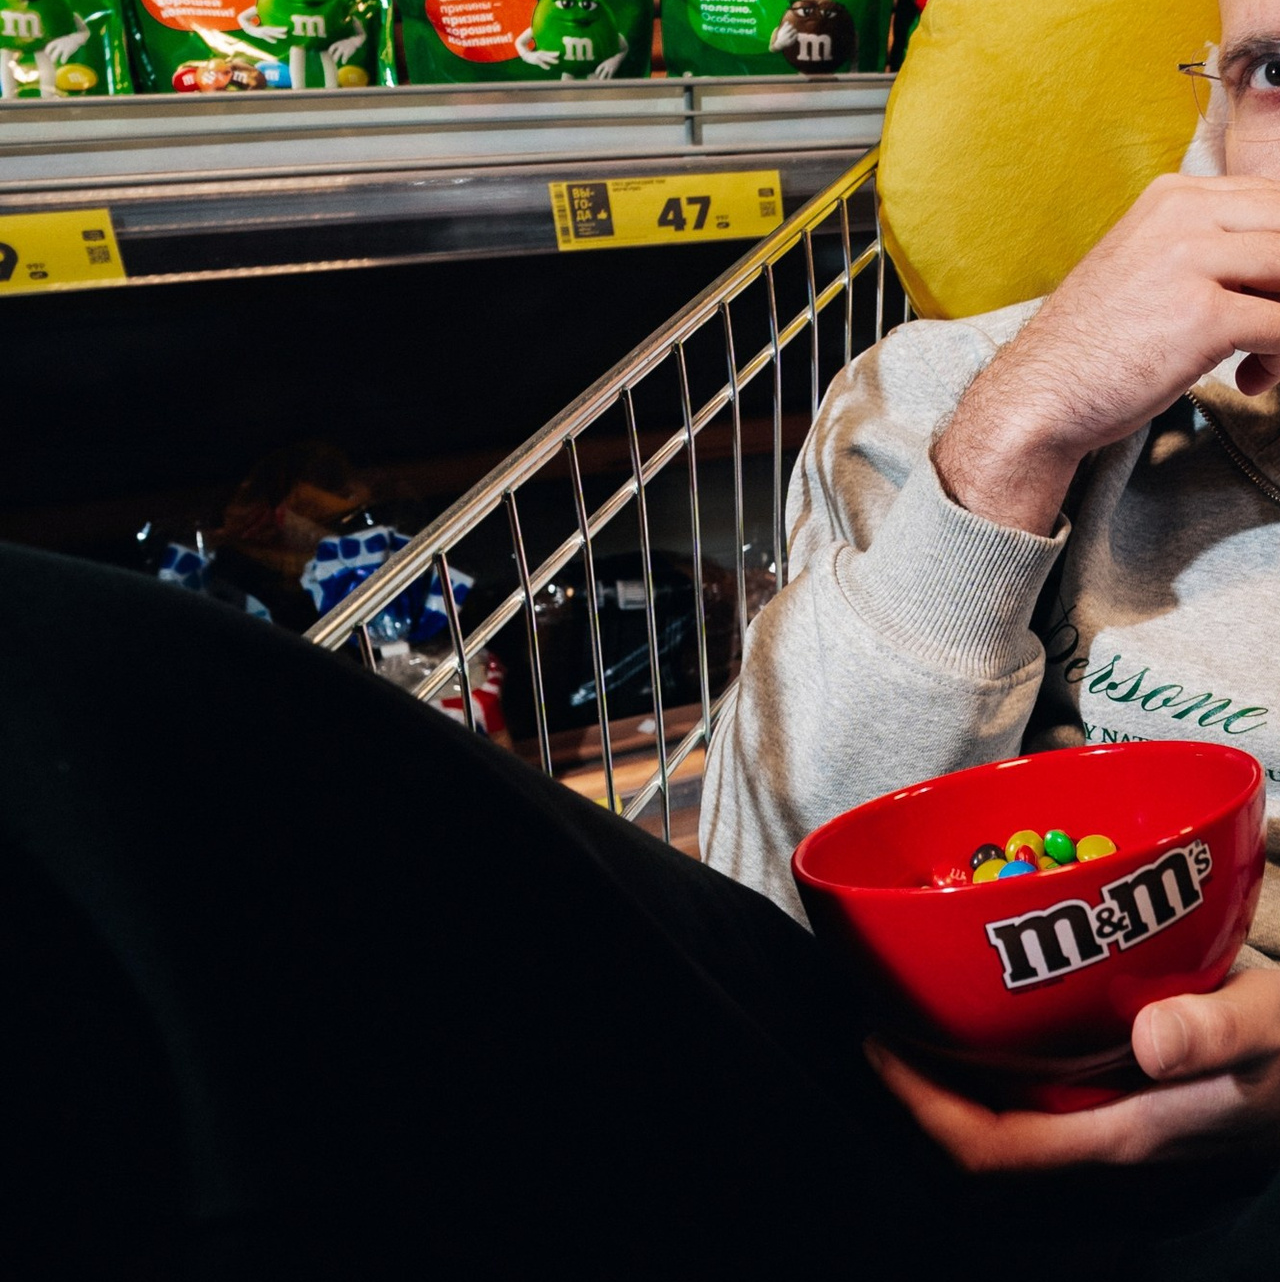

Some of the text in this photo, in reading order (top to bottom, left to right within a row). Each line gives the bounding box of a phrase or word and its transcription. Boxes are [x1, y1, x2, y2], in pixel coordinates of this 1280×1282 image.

[160, 6, 235, 20] компании!
[440, 2, 492, 16] причины
[700, 3, 753, 14] полезно.
[442, 13, 495, 26] признак
[702, 12, 757, 25] Особенно
[446, 23, 502, 38] хорошей
[702, 24, 757, 36] весельем!
[448, 33, 514, 47] компании!
[571, 187, 595, 199] ВЫ-
[572, 198, 593, 210] ГО-
[576, 210, 592, 222] ДА
[657, 195, 712, 231] 47
[985, 839, 1213, 990] m&m's
